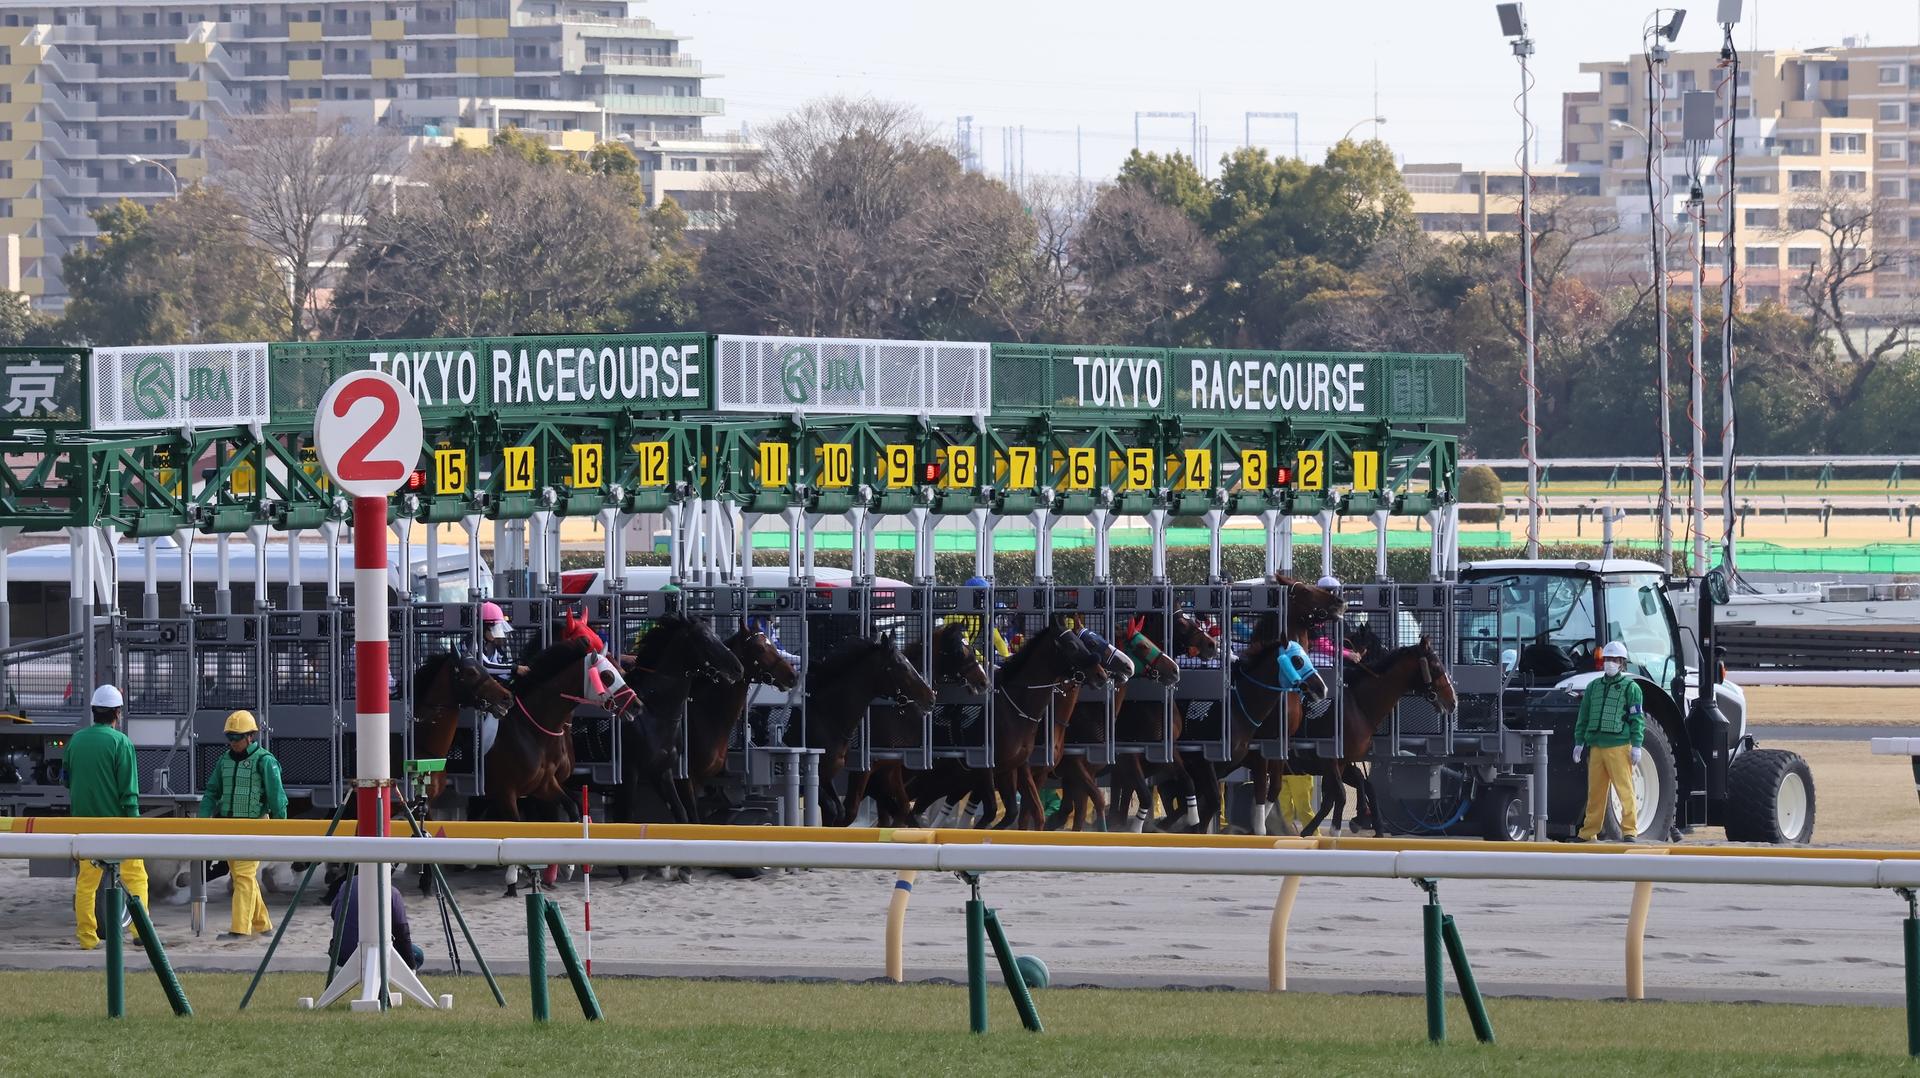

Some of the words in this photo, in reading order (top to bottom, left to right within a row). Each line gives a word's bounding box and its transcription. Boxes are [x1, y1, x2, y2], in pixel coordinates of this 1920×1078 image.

[2, 360, 65, 417] 京
[181, 366, 233, 401] JRA
[492, 345, 700, 403] RACECOURSE
[822, 357, 865, 391] JRA
[1073, 356, 1162, 408] TOKYO
[1191, 359, 1365, 412] RACECOURSE
[333, 377, 405, 482] 2
[440, 453, 462, 490] 15
[510, 450, 530, 487] 14
[578, 448, 598, 484] 13
[645, 445, 664, 482] 12
[767, 446, 782, 482] 11
[829, 447, 848, 483] 10
[892, 449, 908, 483] 9
[954, 449, 969, 484] 8
[1015, 450, 1030, 485] 7
[1075, 451, 1089, 485] 6
[1133, 452, 1147, 486] 5
[1190, 453, 1205, 487] 4
[1247, 453, 1262, 487] 3
[1303, 454, 1317, 487] 2
